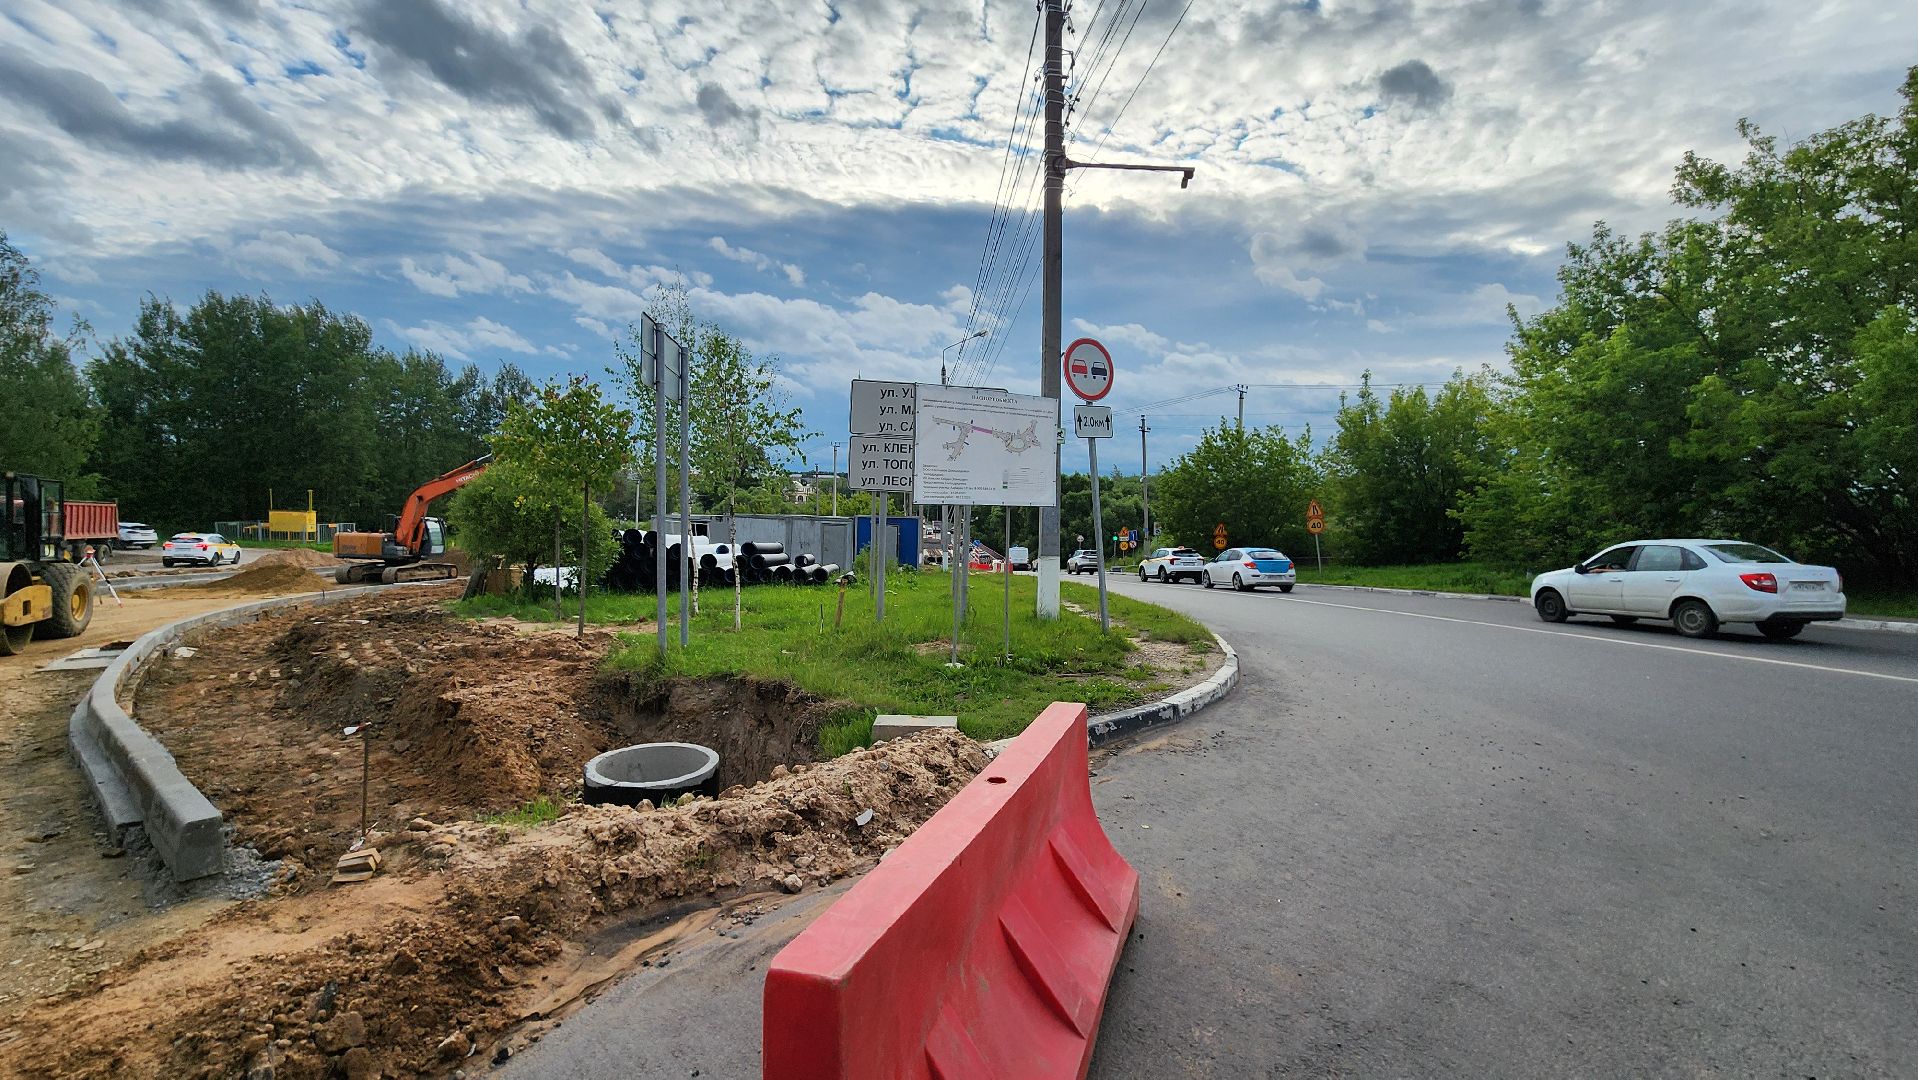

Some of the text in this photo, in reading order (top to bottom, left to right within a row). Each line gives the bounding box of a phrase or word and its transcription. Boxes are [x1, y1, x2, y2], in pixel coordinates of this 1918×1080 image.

[880, 388, 898, 399] ул.
[880, 405, 897, 416] ул.
[901, 404, 914, 415] М
[879, 422, 897, 433] ул.
[862, 443, 880, 454] ул.
[861, 460, 879, 470] ул.
[861, 476, 878, 487] ул.
[1311, 521, 1322, 529] 40
